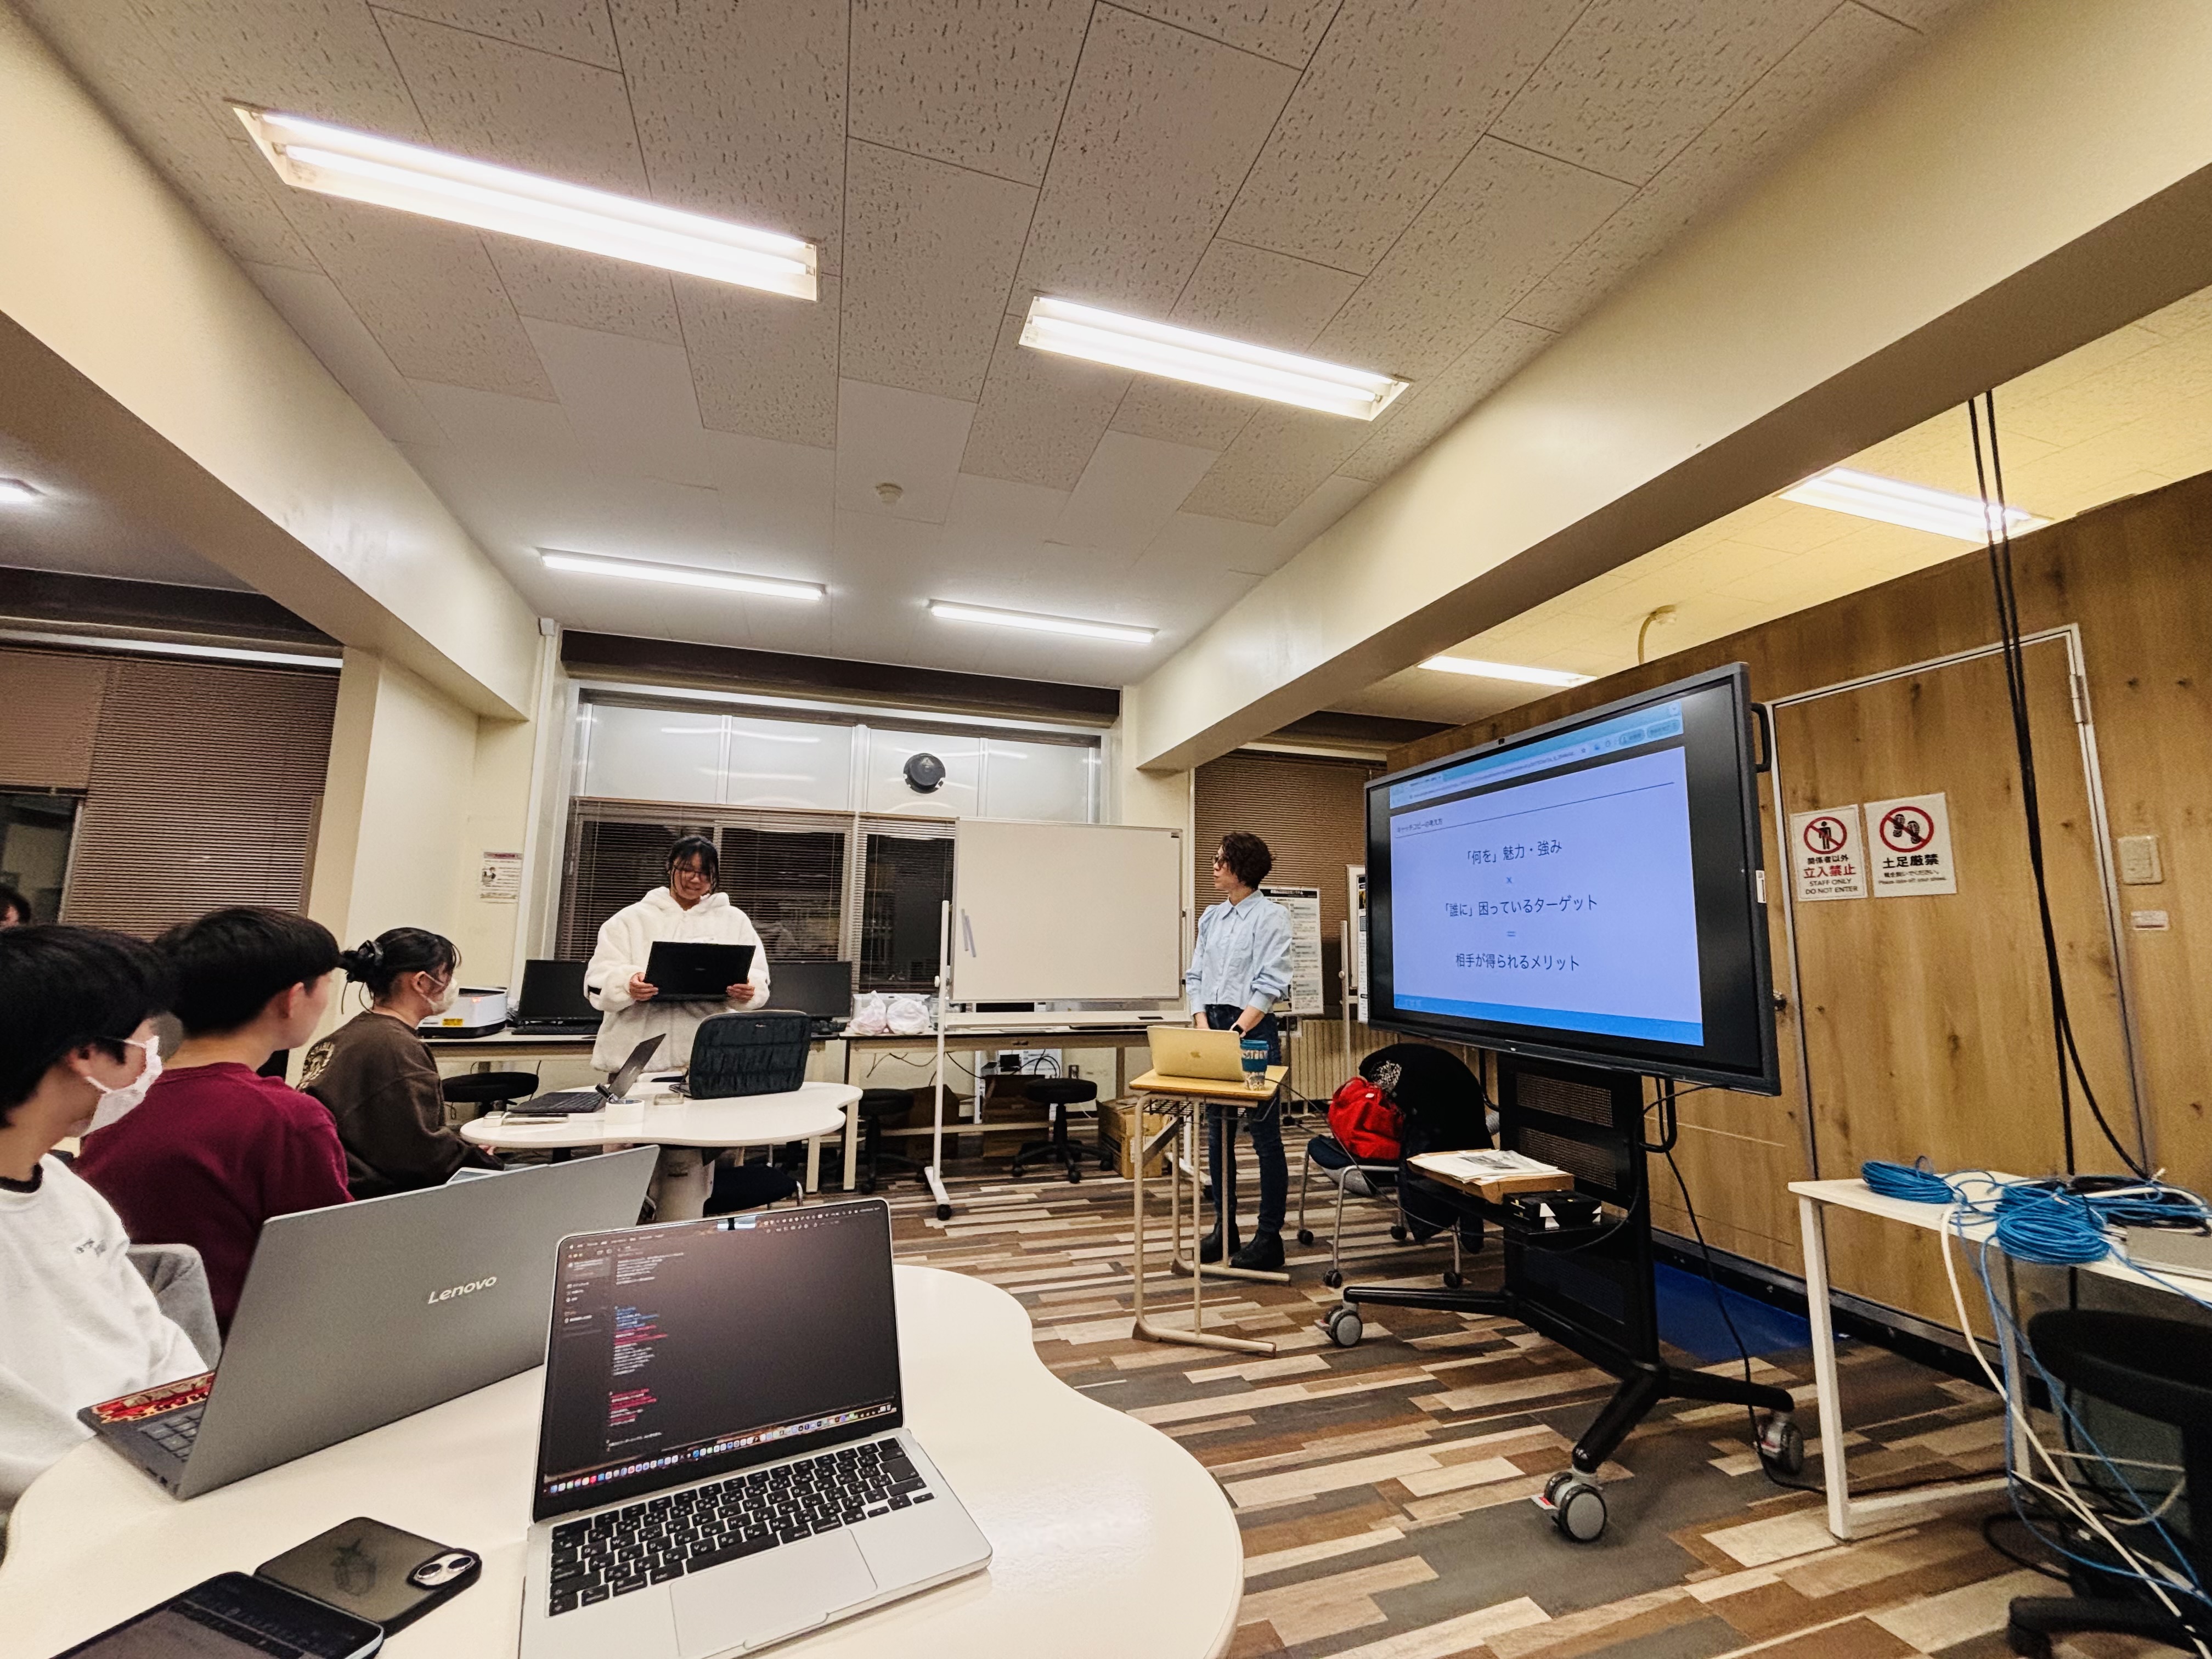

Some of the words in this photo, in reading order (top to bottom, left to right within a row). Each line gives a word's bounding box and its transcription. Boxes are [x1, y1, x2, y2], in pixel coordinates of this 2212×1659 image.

[1808, 854, 1849, 865] 関係者以外
[1883, 854, 1939, 868] 土足厳禁
[1803, 864, 1856, 878] 立入禁止
[1455, 953, 1579, 971] 相手が得られるメリット
[427, 1276, 497, 1304] Lenovo
